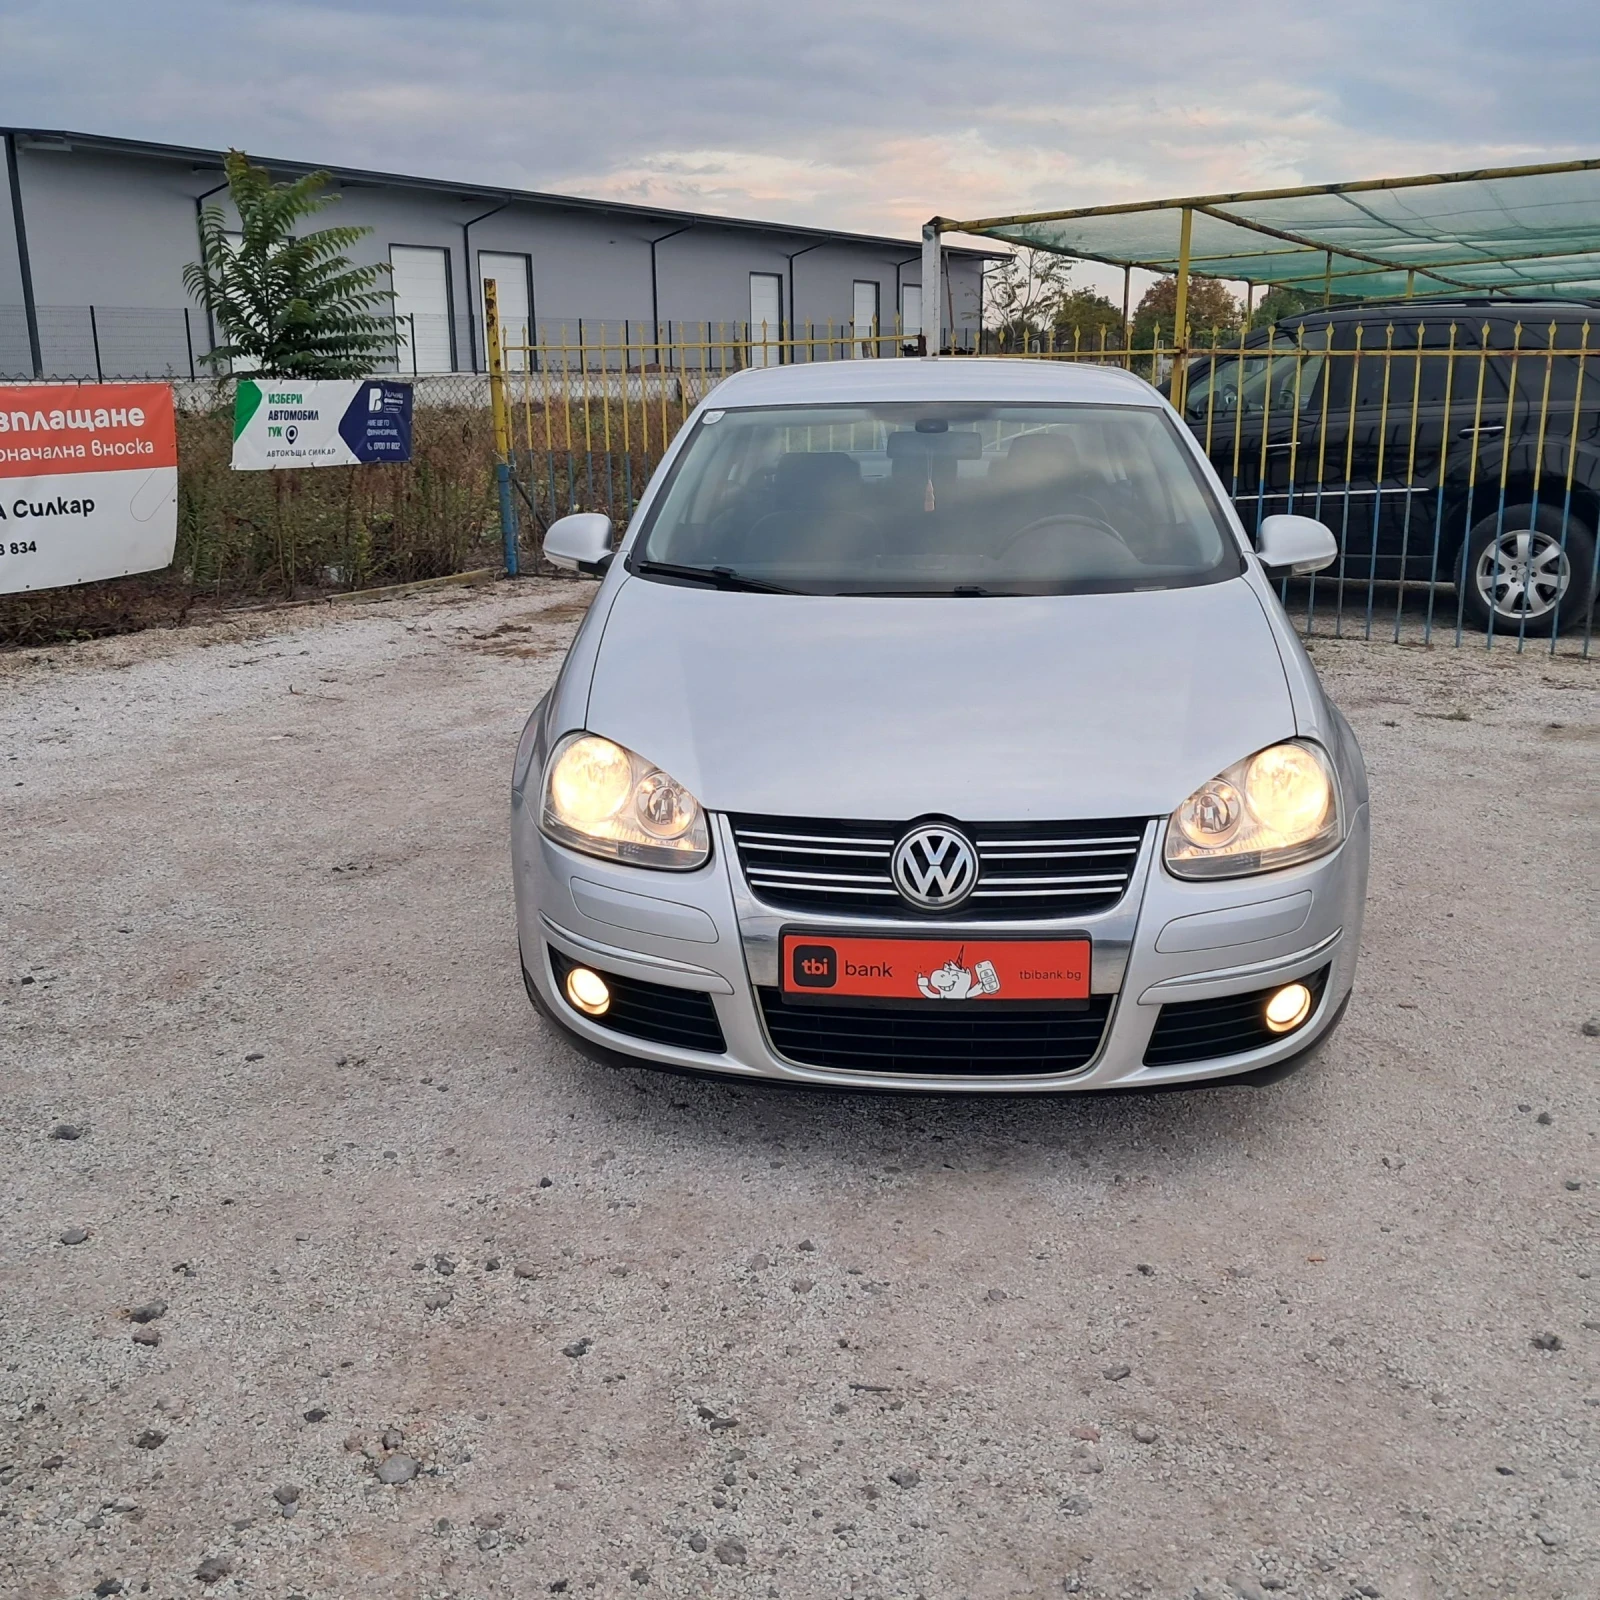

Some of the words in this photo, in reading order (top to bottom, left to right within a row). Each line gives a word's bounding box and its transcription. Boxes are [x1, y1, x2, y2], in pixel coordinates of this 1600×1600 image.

[268, 393, 303, 405] ИЗБЕРИ
[268, 410, 319, 421] АВТОМОБИЛ
[268, 426, 282, 438] ТУК
[91, 437, 154, 457] вноска
[266, 449, 306, 458] АВТОКЪЩА
[308, 448, 336, 456] СИЛКАР
[13, 496, 95, 518] Силкар
[10, 541, 37, 555] 834
[801, 957, 829, 975] tbi
[845, 960, 893, 978] bank
[1019, 969, 1082, 981] tbibank.bg
